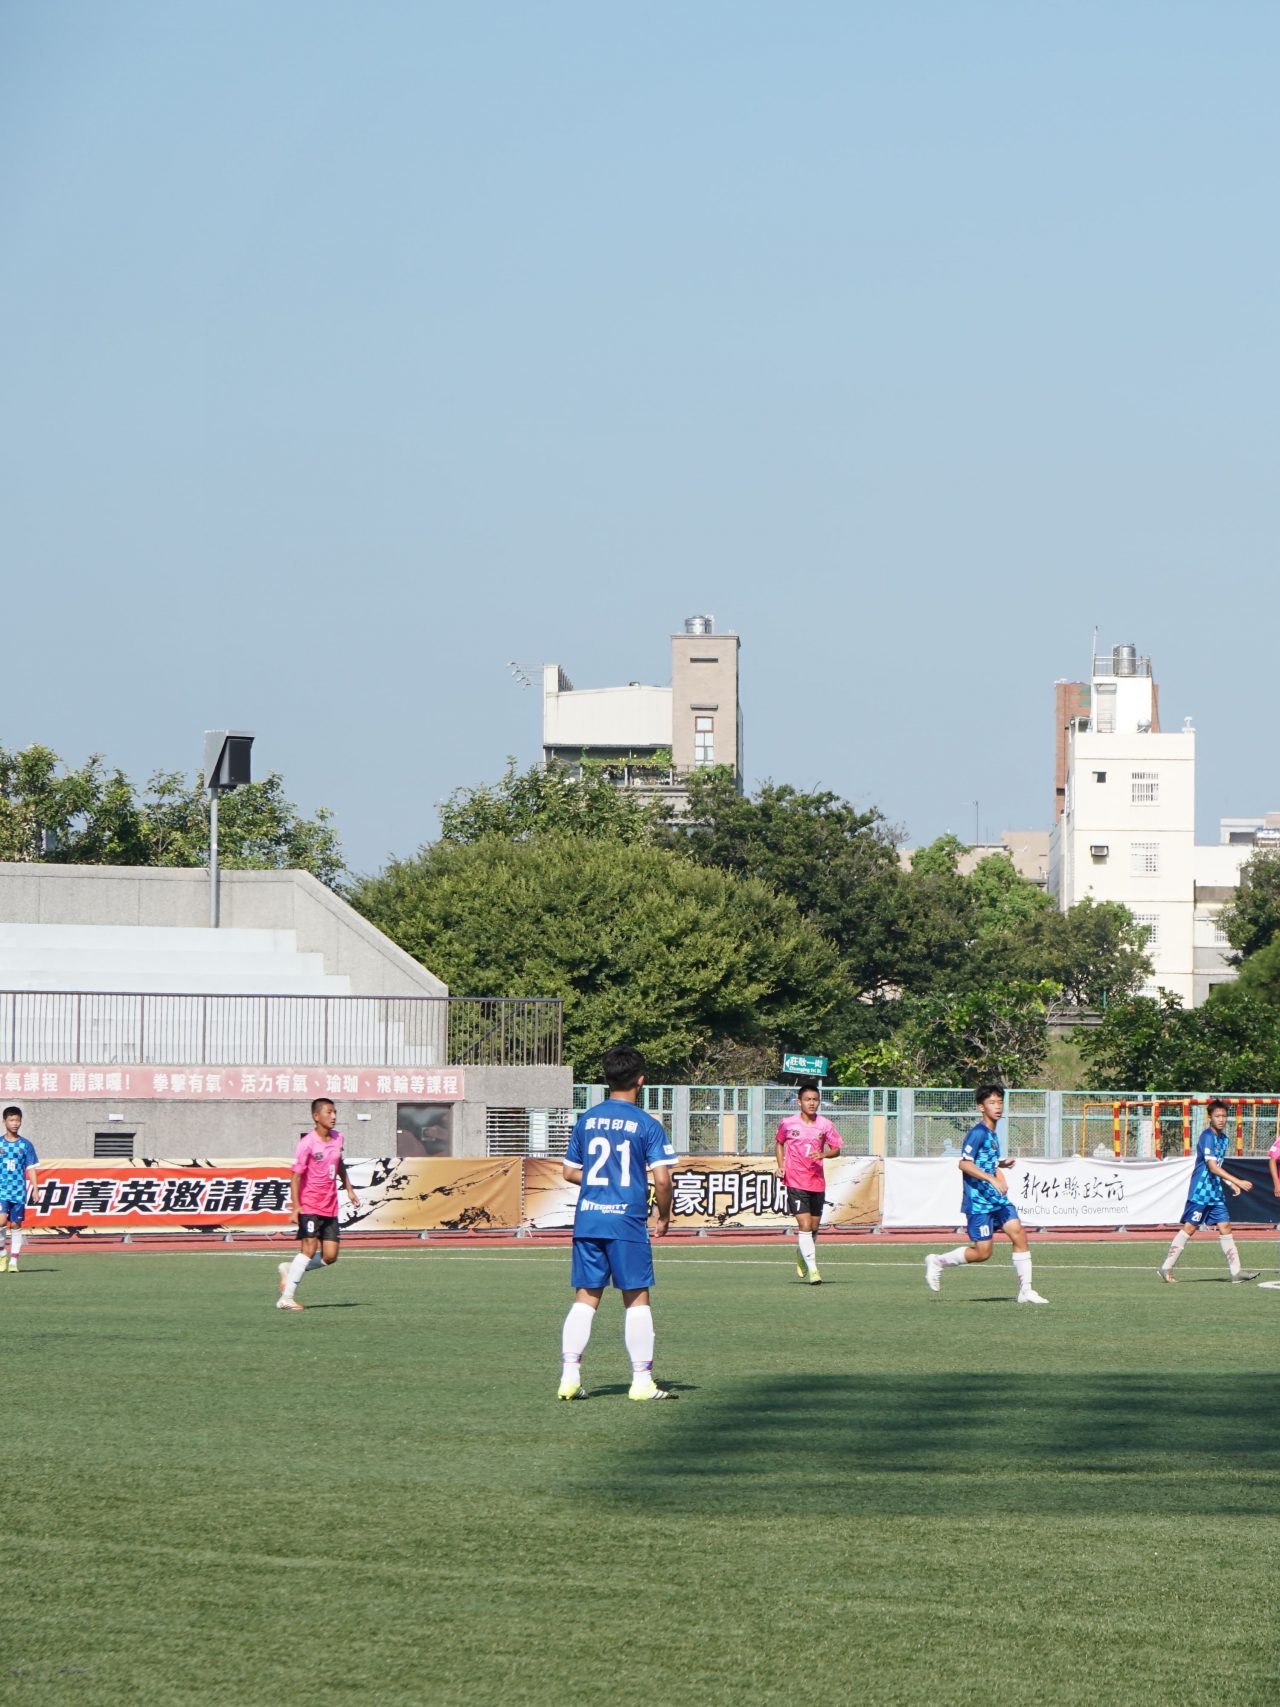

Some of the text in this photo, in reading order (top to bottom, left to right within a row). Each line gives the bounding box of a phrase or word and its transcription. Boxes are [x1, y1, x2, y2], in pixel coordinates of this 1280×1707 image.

[0, 1072, 58, 1092] 氧課程
[805, 1143, 812, 1157] 7
[587, 1137, 630, 1187] 21
[329, 1164, 336, 1179] 9
[1021, 1172, 1124, 1203] 新竹縣政府
[795, 1200, 801, 1211] 7
[1017, 1206, 1129, 1216] HsinChu County Government
[307, 1220, 315, 1233] 9
[979, 1225, 990, 1237] 10
